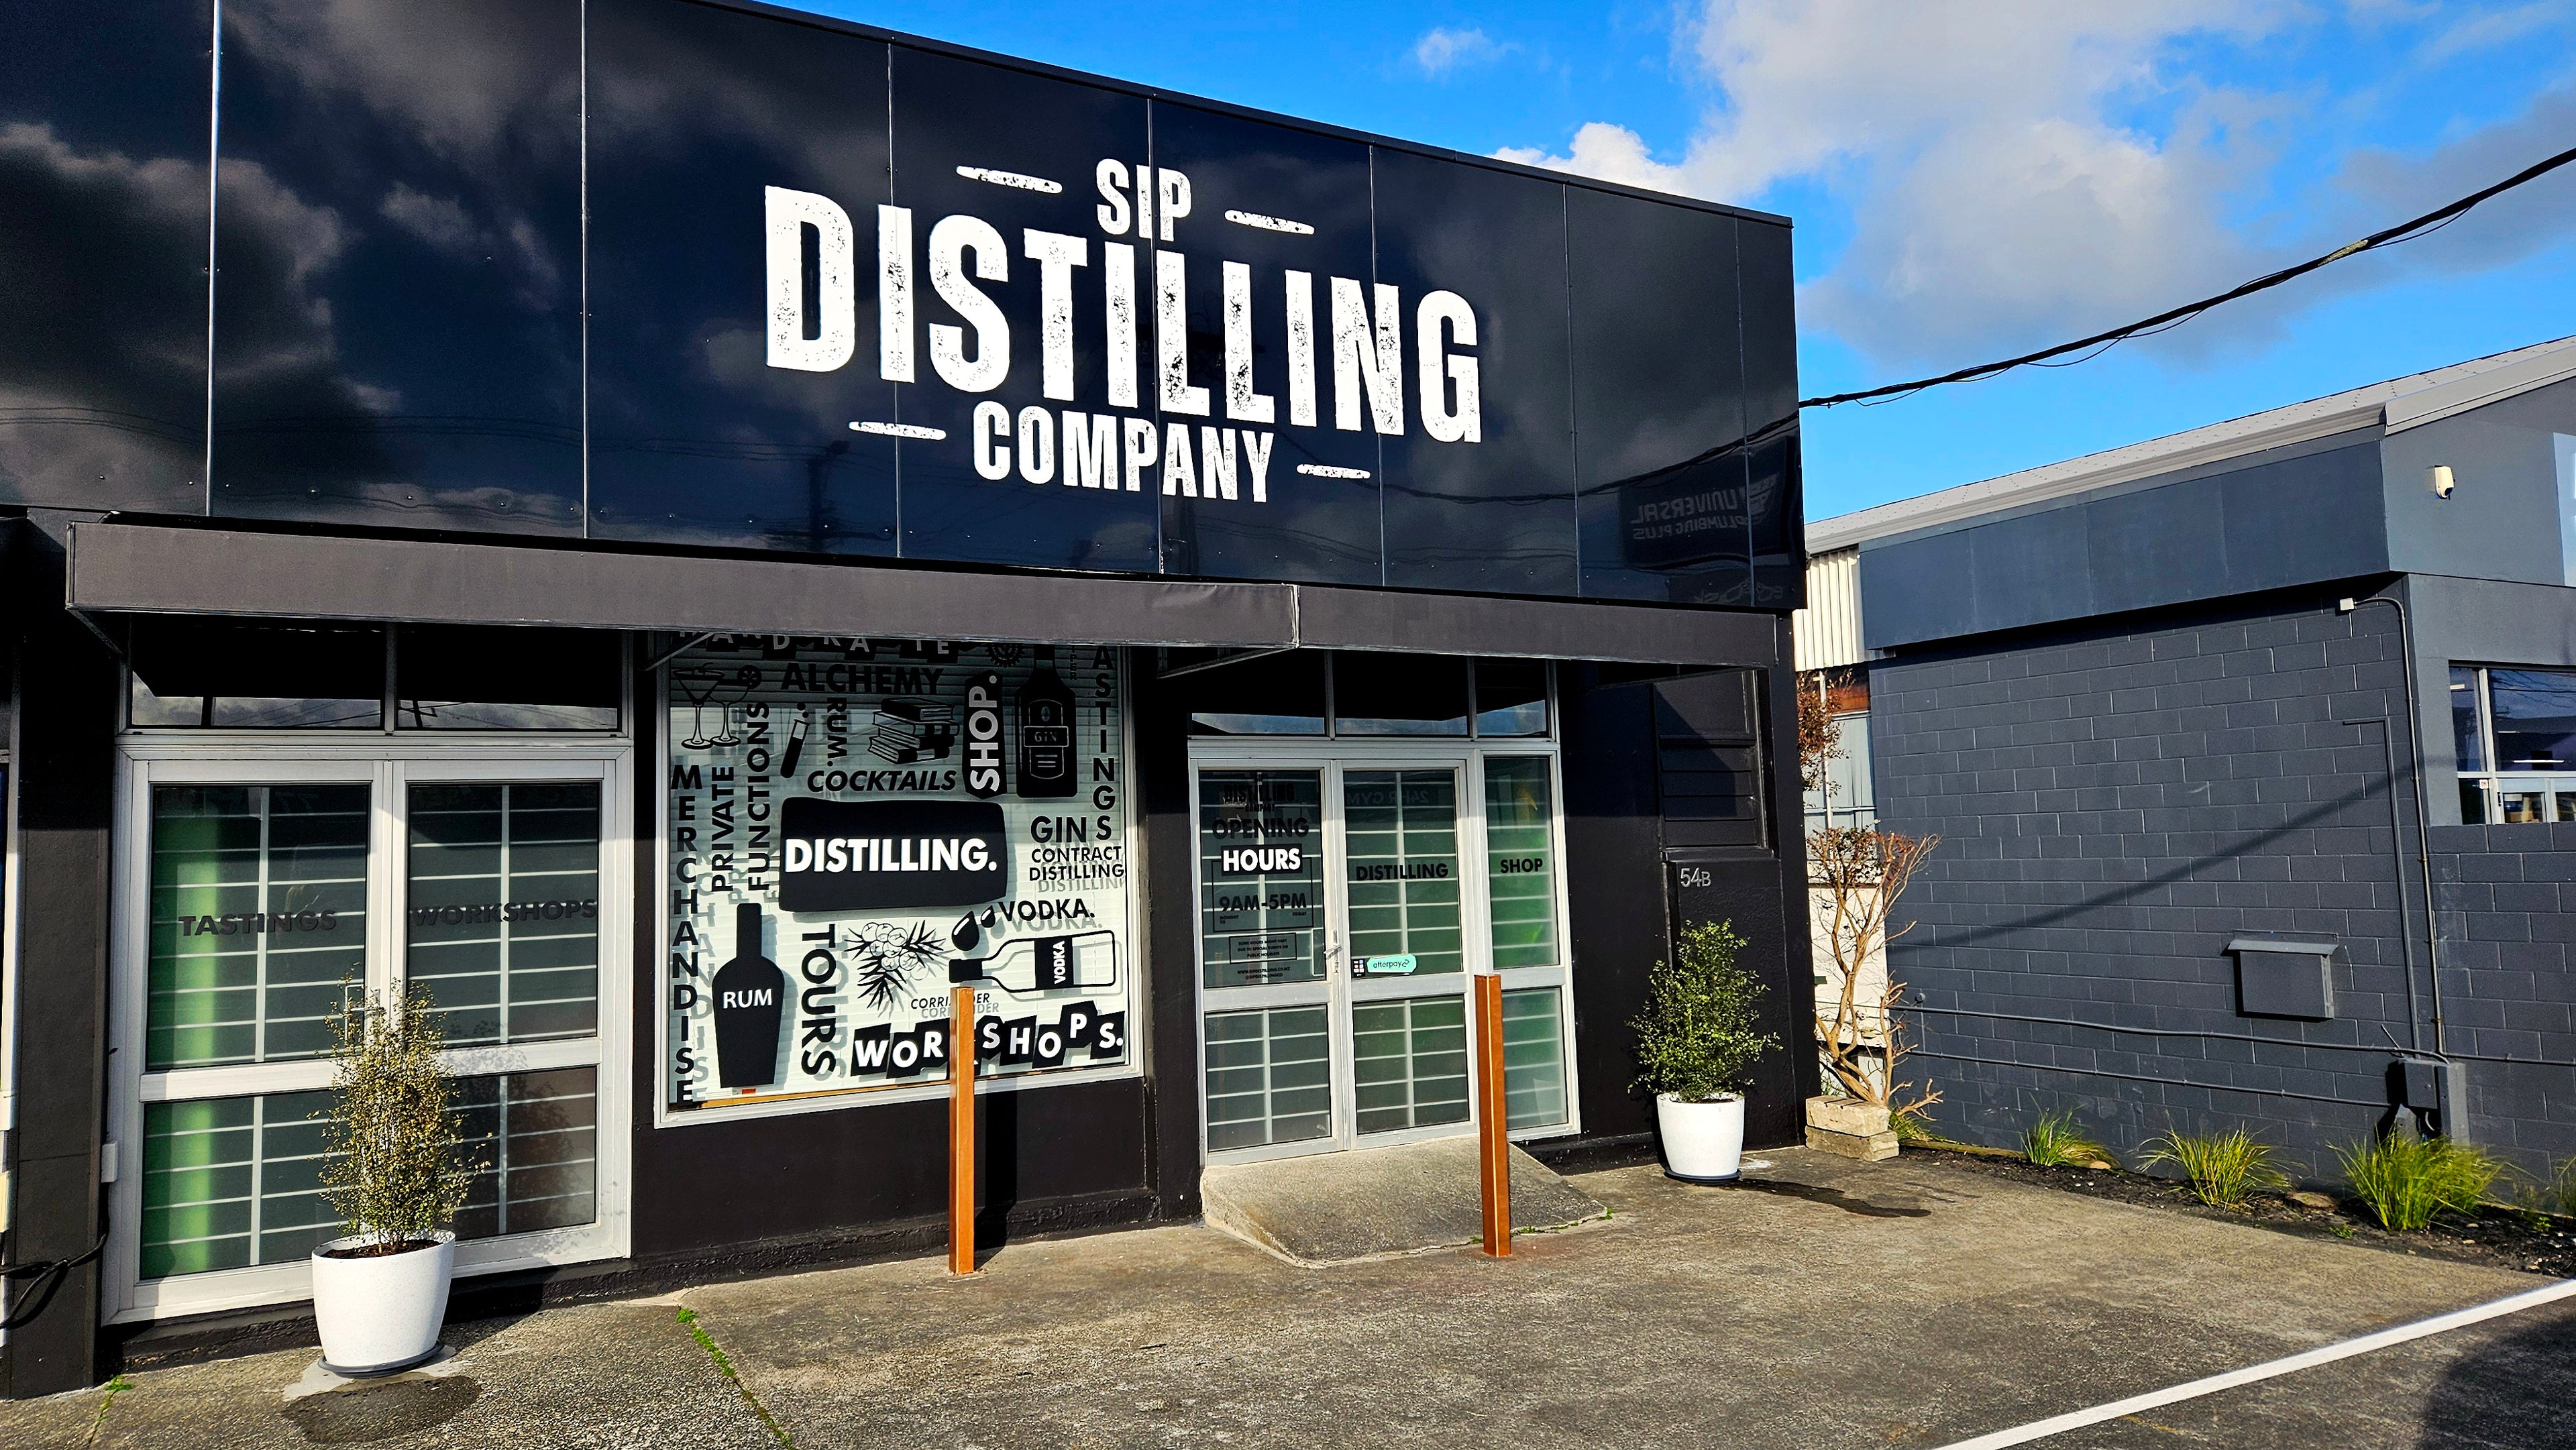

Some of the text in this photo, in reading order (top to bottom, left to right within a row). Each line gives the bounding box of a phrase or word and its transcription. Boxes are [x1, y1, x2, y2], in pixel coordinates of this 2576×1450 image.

[1095, 158, 1192, 241] SIP
[765, 185, 1482, 444] DISTILLING
[973, 400, 1275, 503] COMPANY
[780, 663, 944, 695] ALCHEMY
[826, 697, 847, 767] RUM.
[970, 674, 999, 791] SHOP.
[1091, 646, 1116, 840] ASTINGS
[806, 769, 957, 793] COCKTAILS
[747, 702, 769, 891] FUNCTIONS
[710, 766, 734, 892] PRIVATE
[1212, 817, 1309, 839] OPENING
[784, 839, 997, 873] DISTILLING.
[1031, 846, 1122, 863] CONTRACT
[1223, 848, 1301, 872] HOURS
[1500, 858, 1544, 874] SHOP
[1029, 864, 1124, 881] DISTILLING
[1356, 863, 1448, 881] DISTILLING
[1680, 867, 1711, 888] 54B
[411, 898, 598, 927] WORKSHOPS
[998, 898, 1095, 922] VODKA.
[1219, 893, 1307, 911] 9AM-5PM
[178, 910, 337, 936] TASTINGS
[672, 764, 702, 1105] MERCHANDISE
[1053, 940, 1065, 984] VODKA
[1373, 960, 1402, 969] afterpay
[723, 989, 773, 1008] RUM
[801, 924, 836, 1074] TOURS
[853, 1013, 1124, 1068] WORSHOPS.
